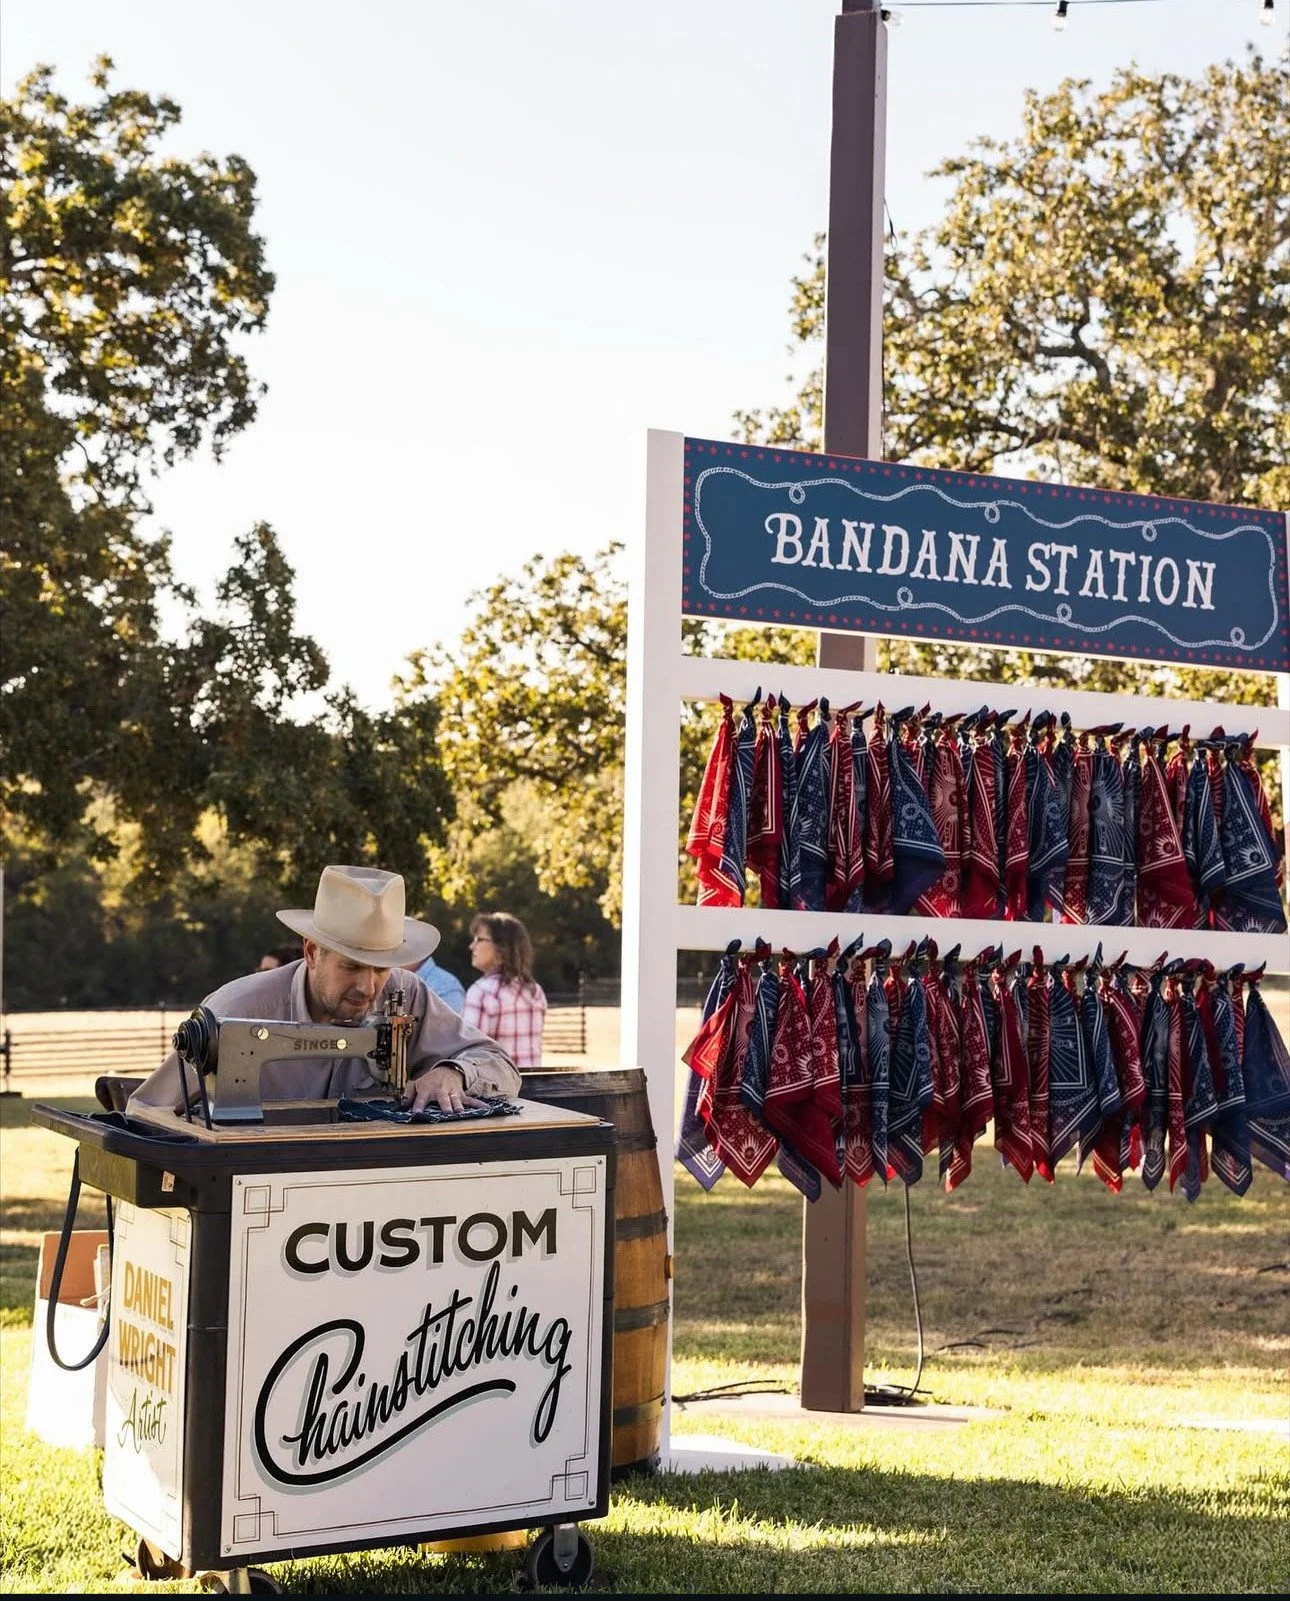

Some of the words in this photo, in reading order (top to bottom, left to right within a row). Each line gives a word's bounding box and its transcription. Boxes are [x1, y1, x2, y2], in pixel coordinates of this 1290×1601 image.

[764, 512, 1012, 589] BANDANA
[1026, 542, 1217, 610] STATION
[284, 1207, 557, 1274] CUSTOM
[123, 1261, 174, 1330] DANIEL
[118, 1319, 176, 1394] WRIGHT
[254, 1260, 573, 1486] Chainstitching
[117, 1388, 167, 1454] Artist
